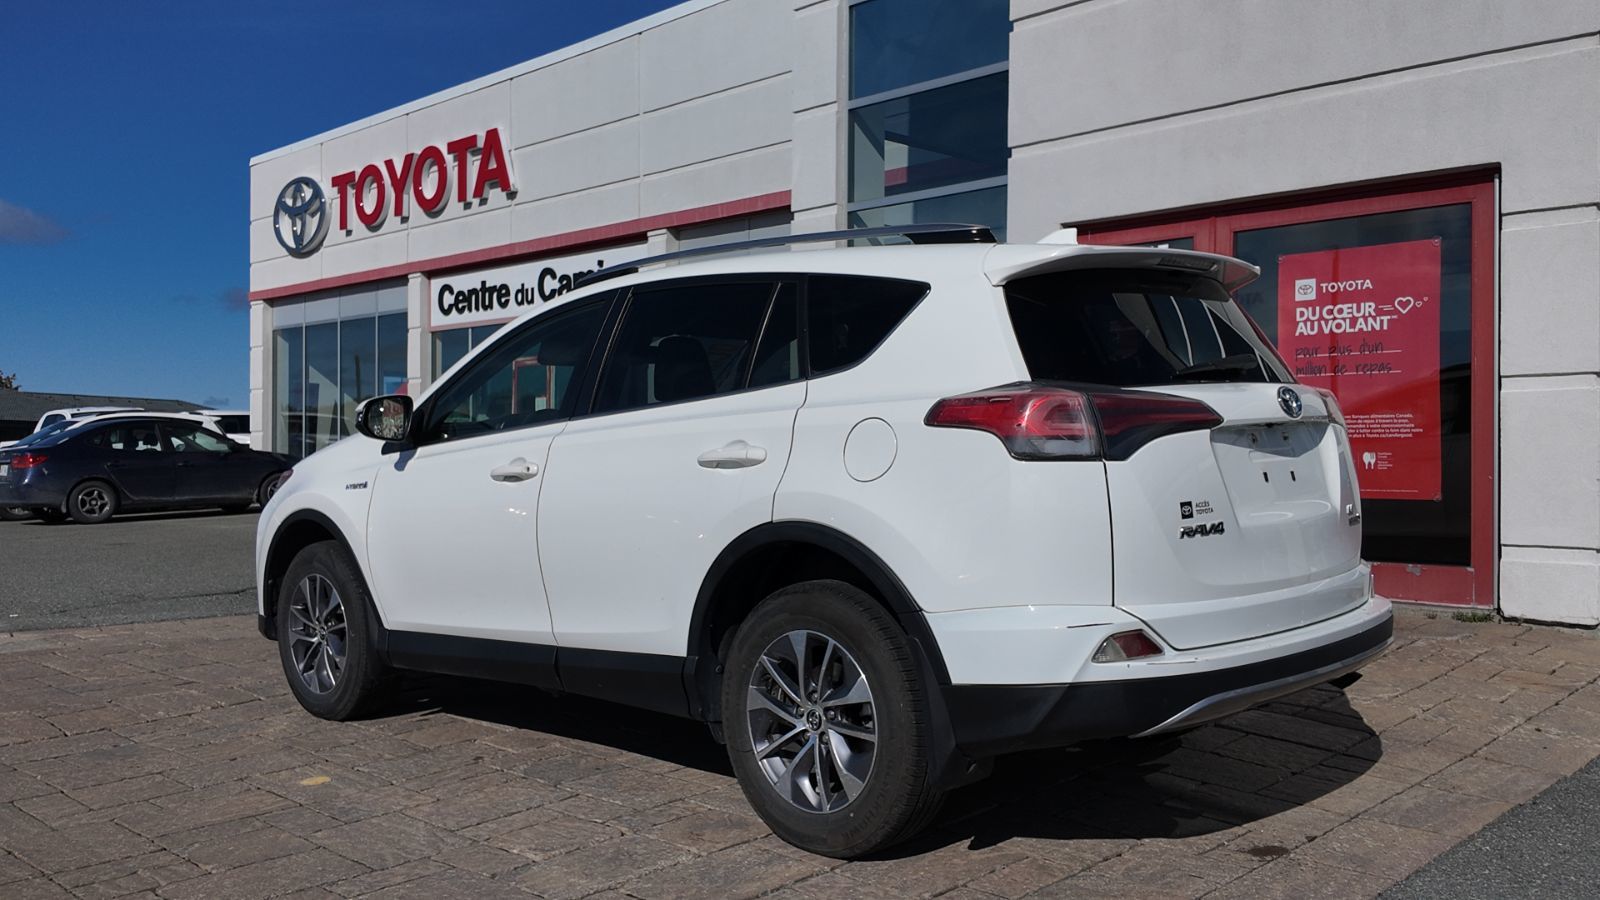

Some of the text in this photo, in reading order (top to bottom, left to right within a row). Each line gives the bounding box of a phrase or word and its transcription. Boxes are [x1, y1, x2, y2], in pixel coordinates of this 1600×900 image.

[331, 127, 512, 231] TOYOTA
[1320, 279, 1373, 294] TOYOTA
[438, 280, 511, 316] Centre
[515, 283, 535, 306] du
[1296, 302, 1376, 322] DU CŒUR
[1295, 316, 1391, 336] AU VOLANT
[1328, 340, 1352, 357] plus
[1334, 360, 1347, 375] de
[1355, 362, 1392, 377] repas
[1179, 520, 1225, 539] RAV4
